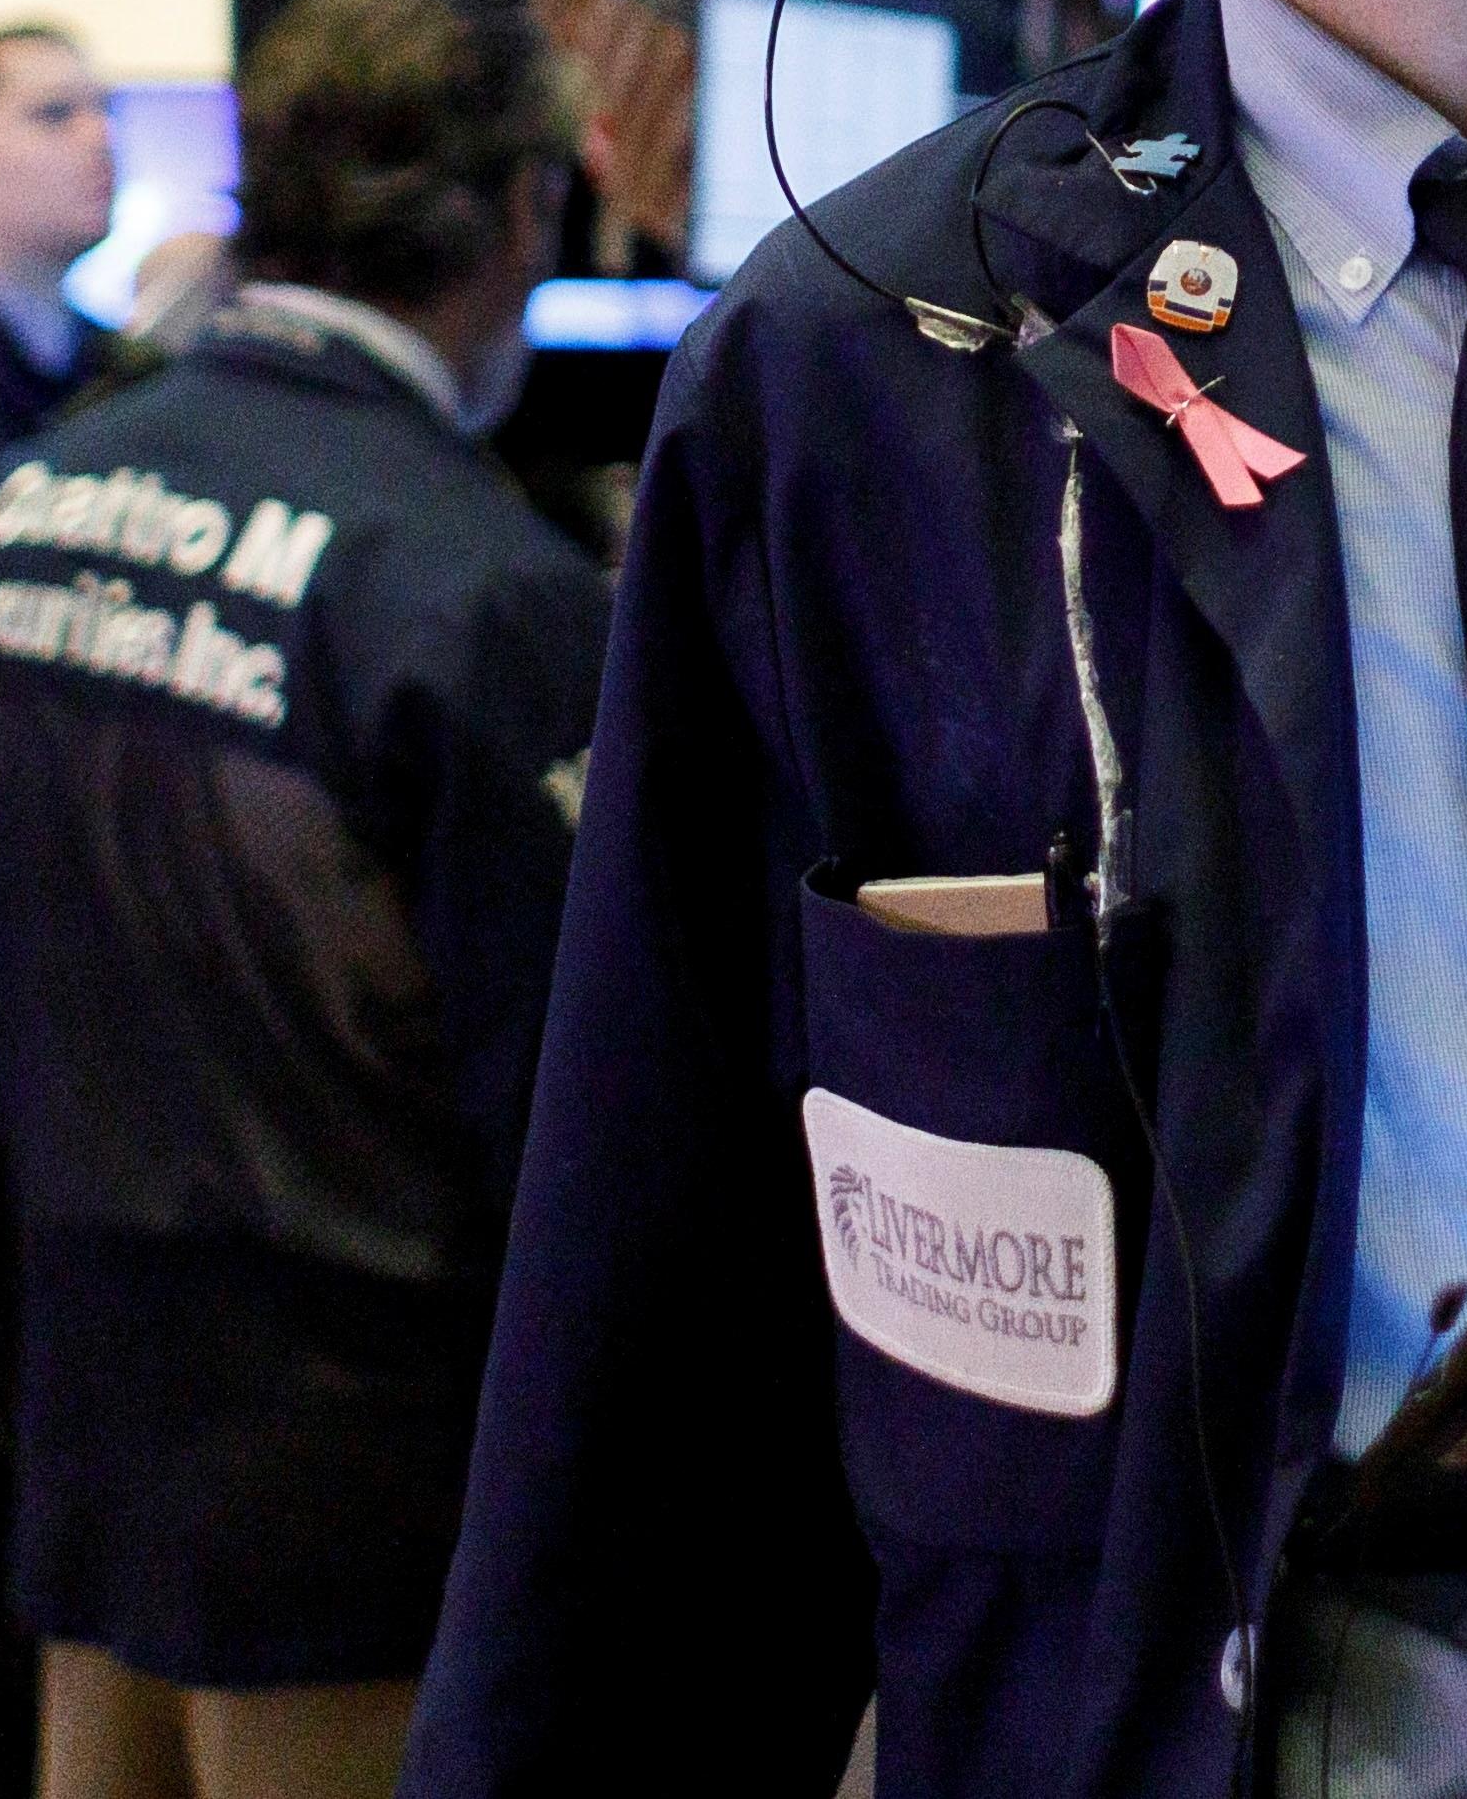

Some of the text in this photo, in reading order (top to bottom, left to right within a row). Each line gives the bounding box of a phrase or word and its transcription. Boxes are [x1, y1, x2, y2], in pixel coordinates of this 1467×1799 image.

[860, 1175, 1087, 1304] LIVERMORE
[871, 1251, 1087, 1349] TRADING GROUP
